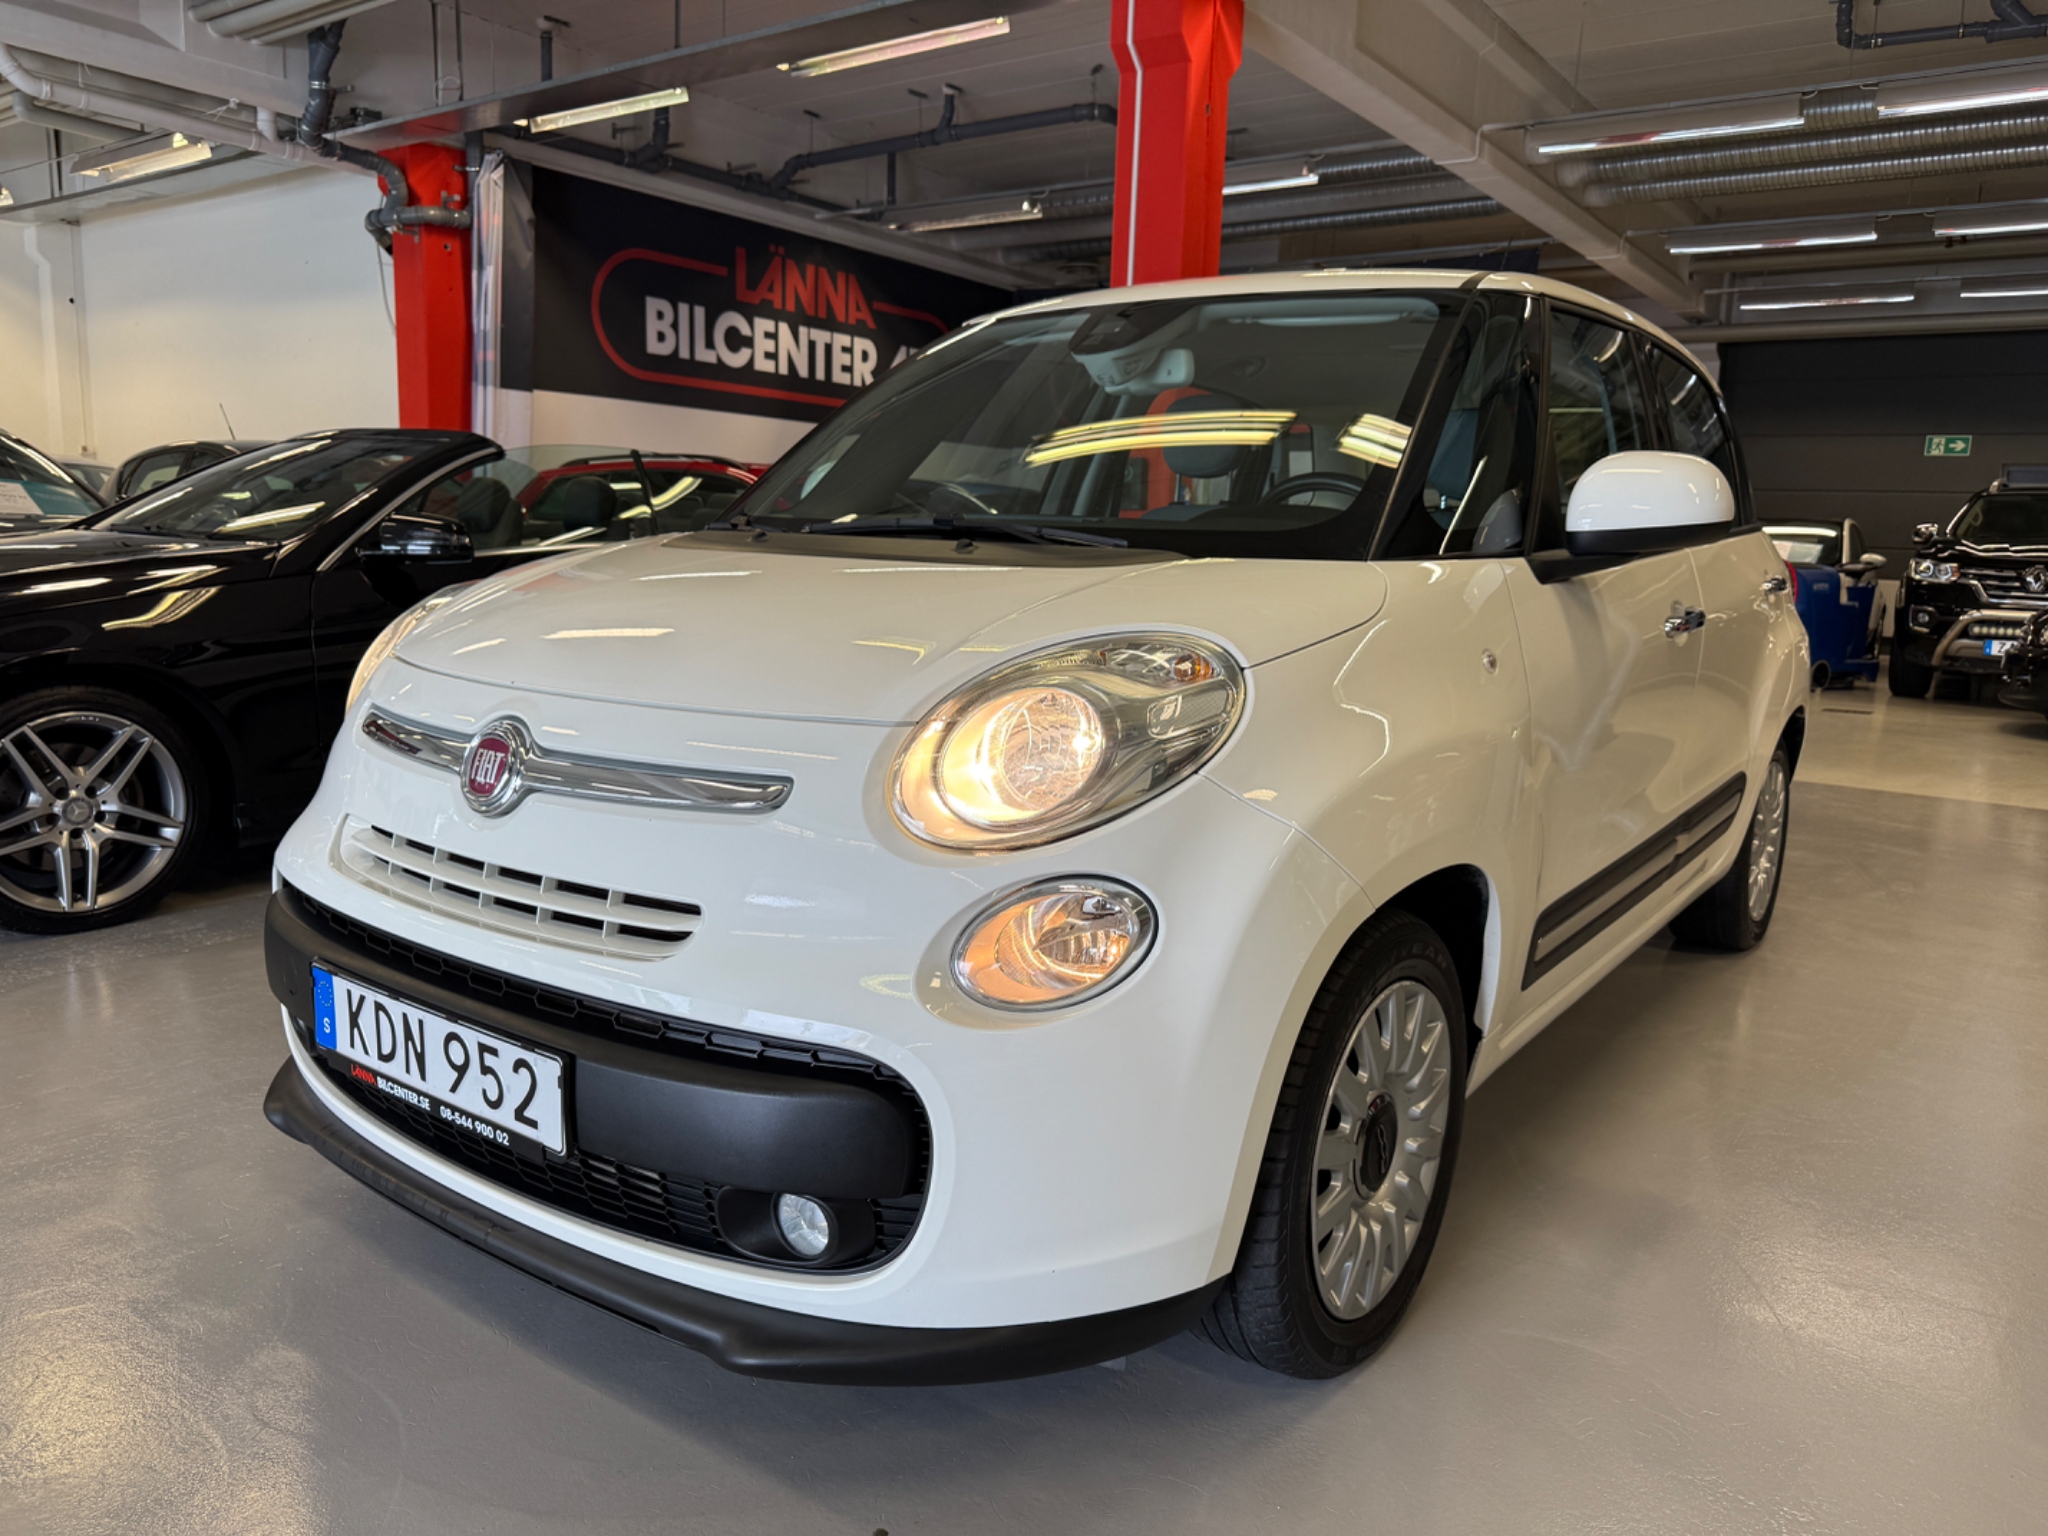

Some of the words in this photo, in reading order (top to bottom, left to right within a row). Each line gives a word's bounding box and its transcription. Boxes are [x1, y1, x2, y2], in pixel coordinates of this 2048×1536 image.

[735, 244, 877, 330] LÄNNA
[645, 295, 879, 388] BILCENTER
[471, 748, 506, 784] FIAT
[323, 1017, 331, 1034] S
[346, 988, 427, 1083] KDN
[442, 1031, 539, 1131] 952
[376, 1075, 431, 1111] BILCENTER.SE
[439, 1105, 473, 1131] 08-544
[474, 1120, 494, 1139] 900
[495, 1129, 510, 1146] 02
